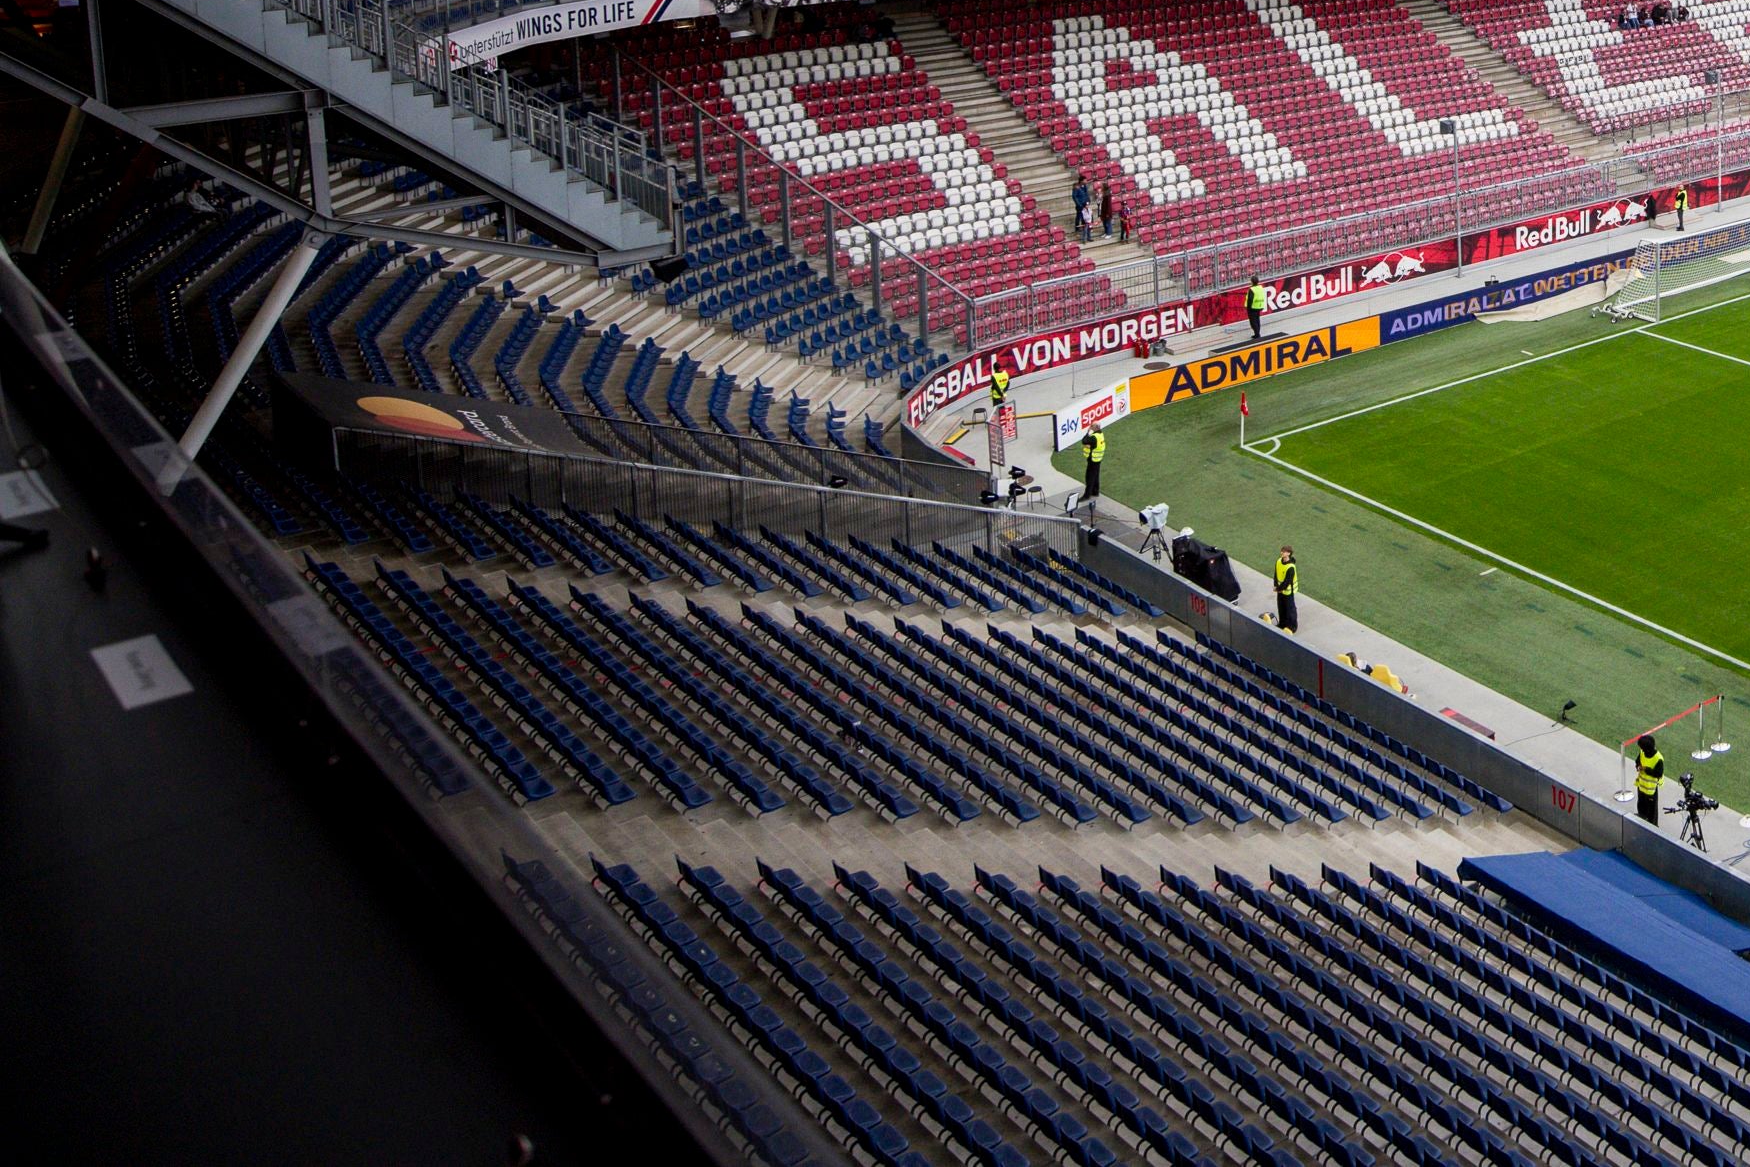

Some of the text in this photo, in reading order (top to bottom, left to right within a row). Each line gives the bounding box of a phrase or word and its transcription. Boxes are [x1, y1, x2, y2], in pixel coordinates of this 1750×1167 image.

[460, 30, 514, 59] unterstützt
[516, 12, 562, 41] WINGS
[568, 7, 598, 31] FOR
[603, 0, 635, 24] LIFE
[1515, 209, 1590, 251] Red Bull
[1261, 265, 1353, 313] Red Bull
[1012, 334, 1070, 371] VON
[1080, 305, 1194, 357] MORGEN
[1164, 326, 1352, 404] ADMIRAL
[1061, 399, 1112, 435] sky sport
[1552, 784, 1576, 815] 107
